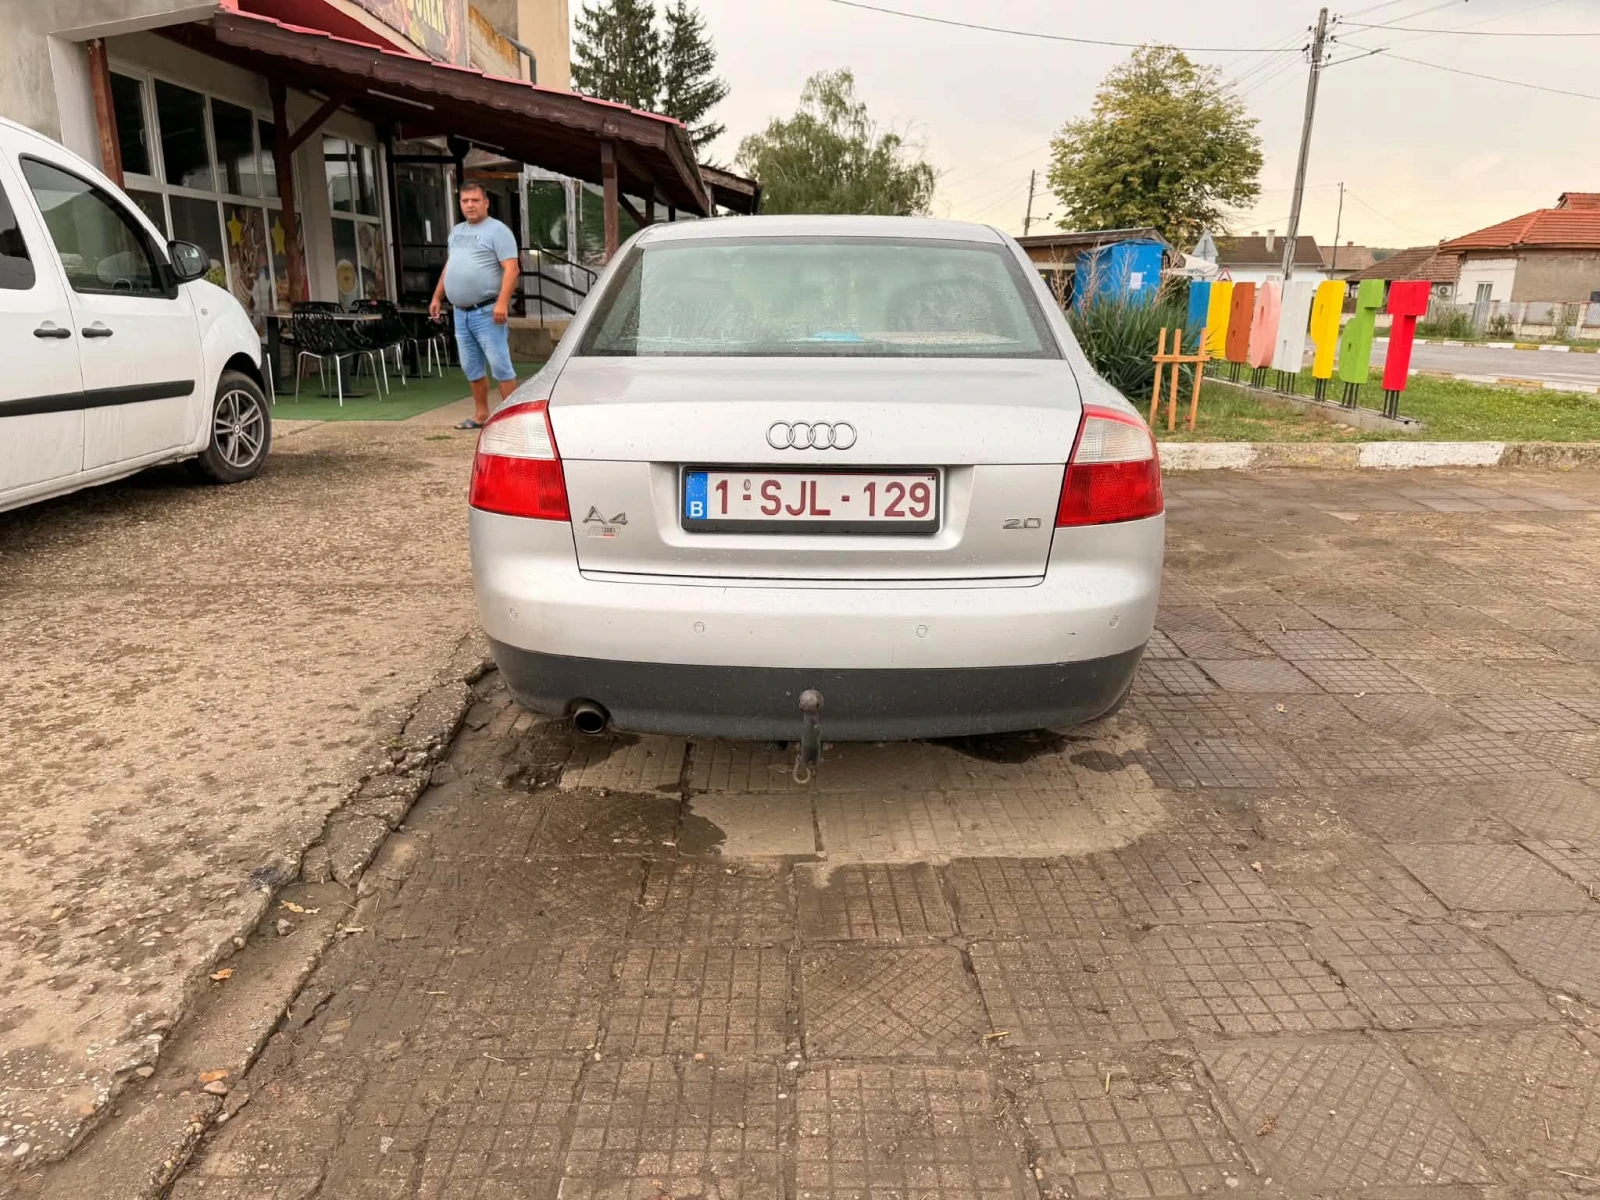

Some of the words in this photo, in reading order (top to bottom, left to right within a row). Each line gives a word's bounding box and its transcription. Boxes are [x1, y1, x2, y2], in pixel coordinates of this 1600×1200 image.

[582, 505, 628, 525] A4
[690, 501, 704, 517] B
[1002, 517, 1041, 529] 2.0
